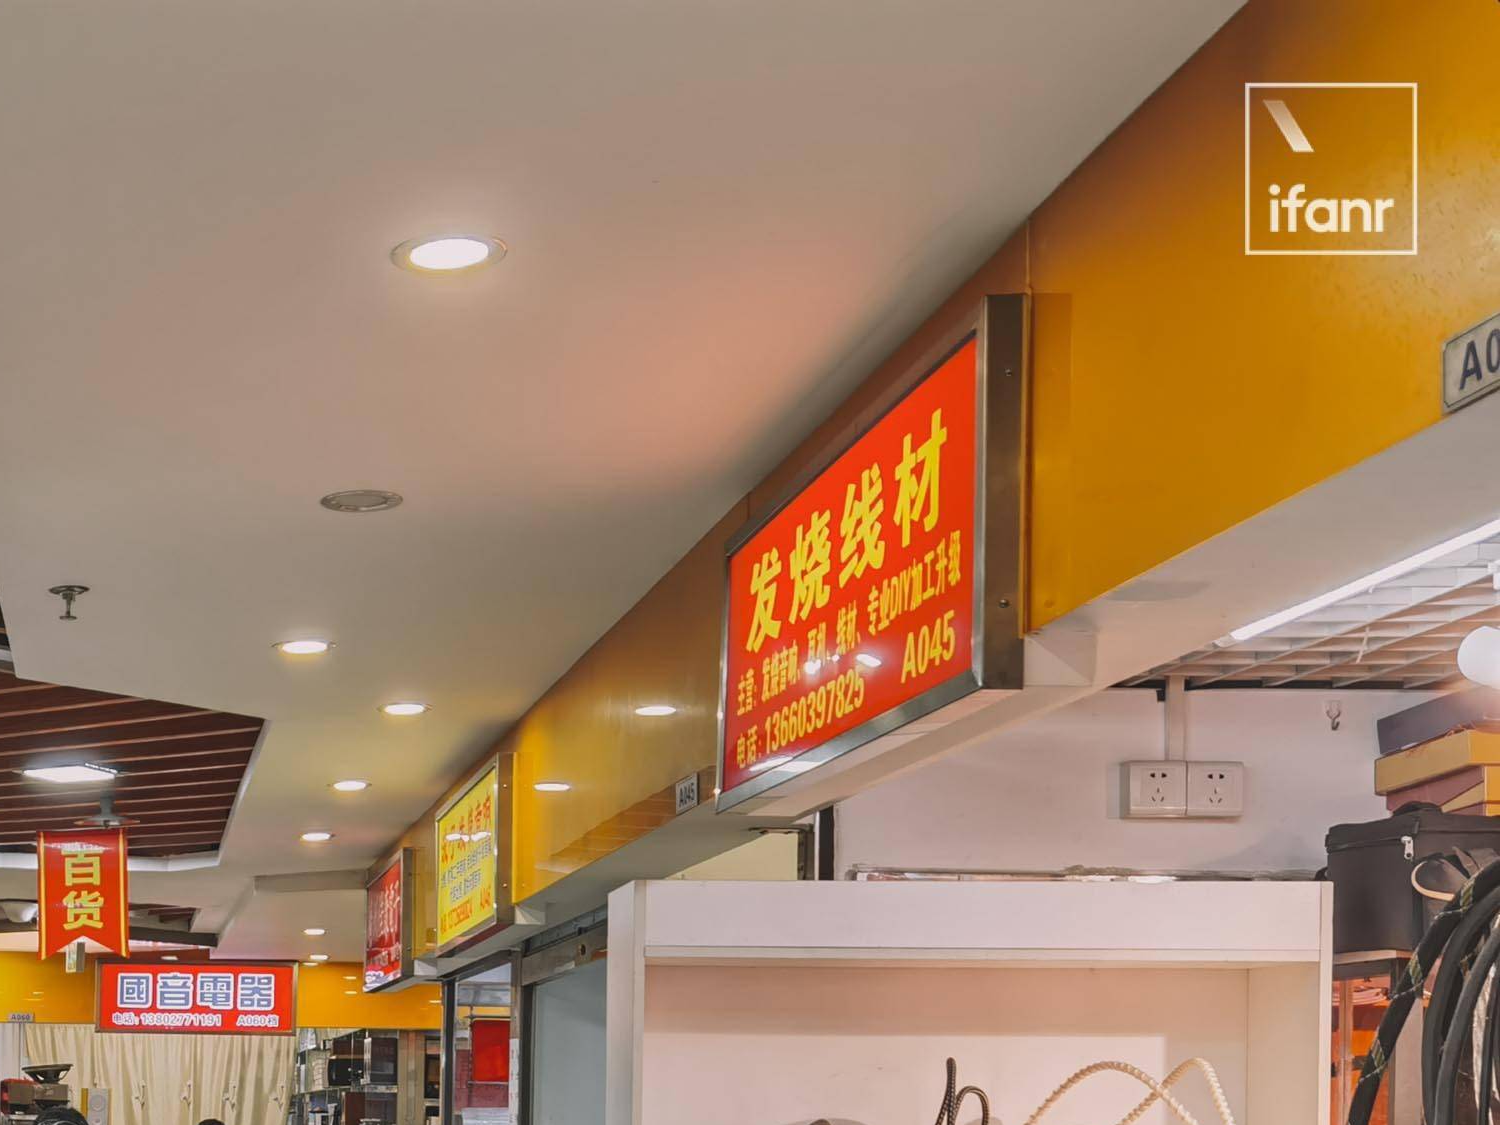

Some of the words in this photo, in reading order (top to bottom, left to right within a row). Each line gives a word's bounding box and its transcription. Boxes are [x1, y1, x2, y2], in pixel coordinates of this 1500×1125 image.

[745, 408, 948, 653] 发烧线材
[900, 609, 956, 684] A045
[60, 847, 105, 932] 百货
[117, 972, 275, 1011] 國音電器
